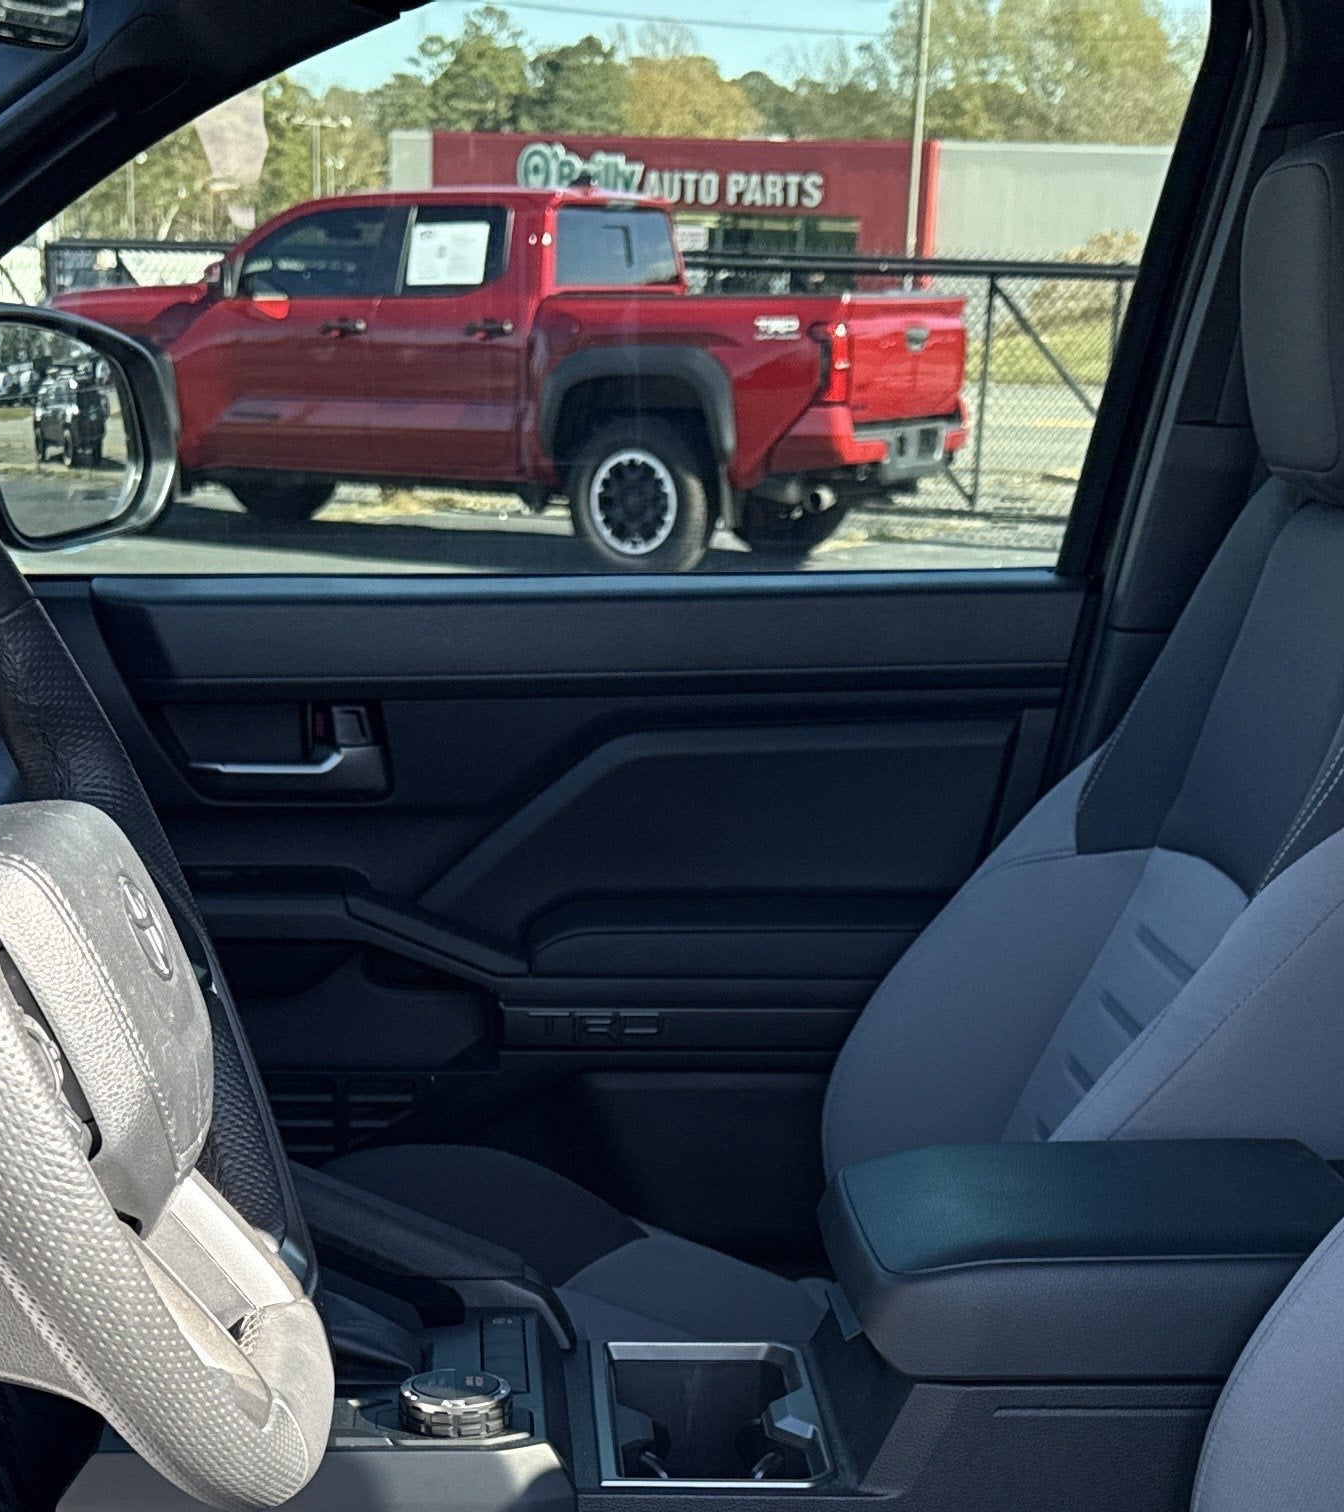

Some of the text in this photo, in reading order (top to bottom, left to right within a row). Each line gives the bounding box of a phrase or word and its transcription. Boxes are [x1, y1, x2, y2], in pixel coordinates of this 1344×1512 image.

[517, 142, 824, 207] O'Rilly AUTO PARTS
[527, 1008, 666, 1040] TRD
